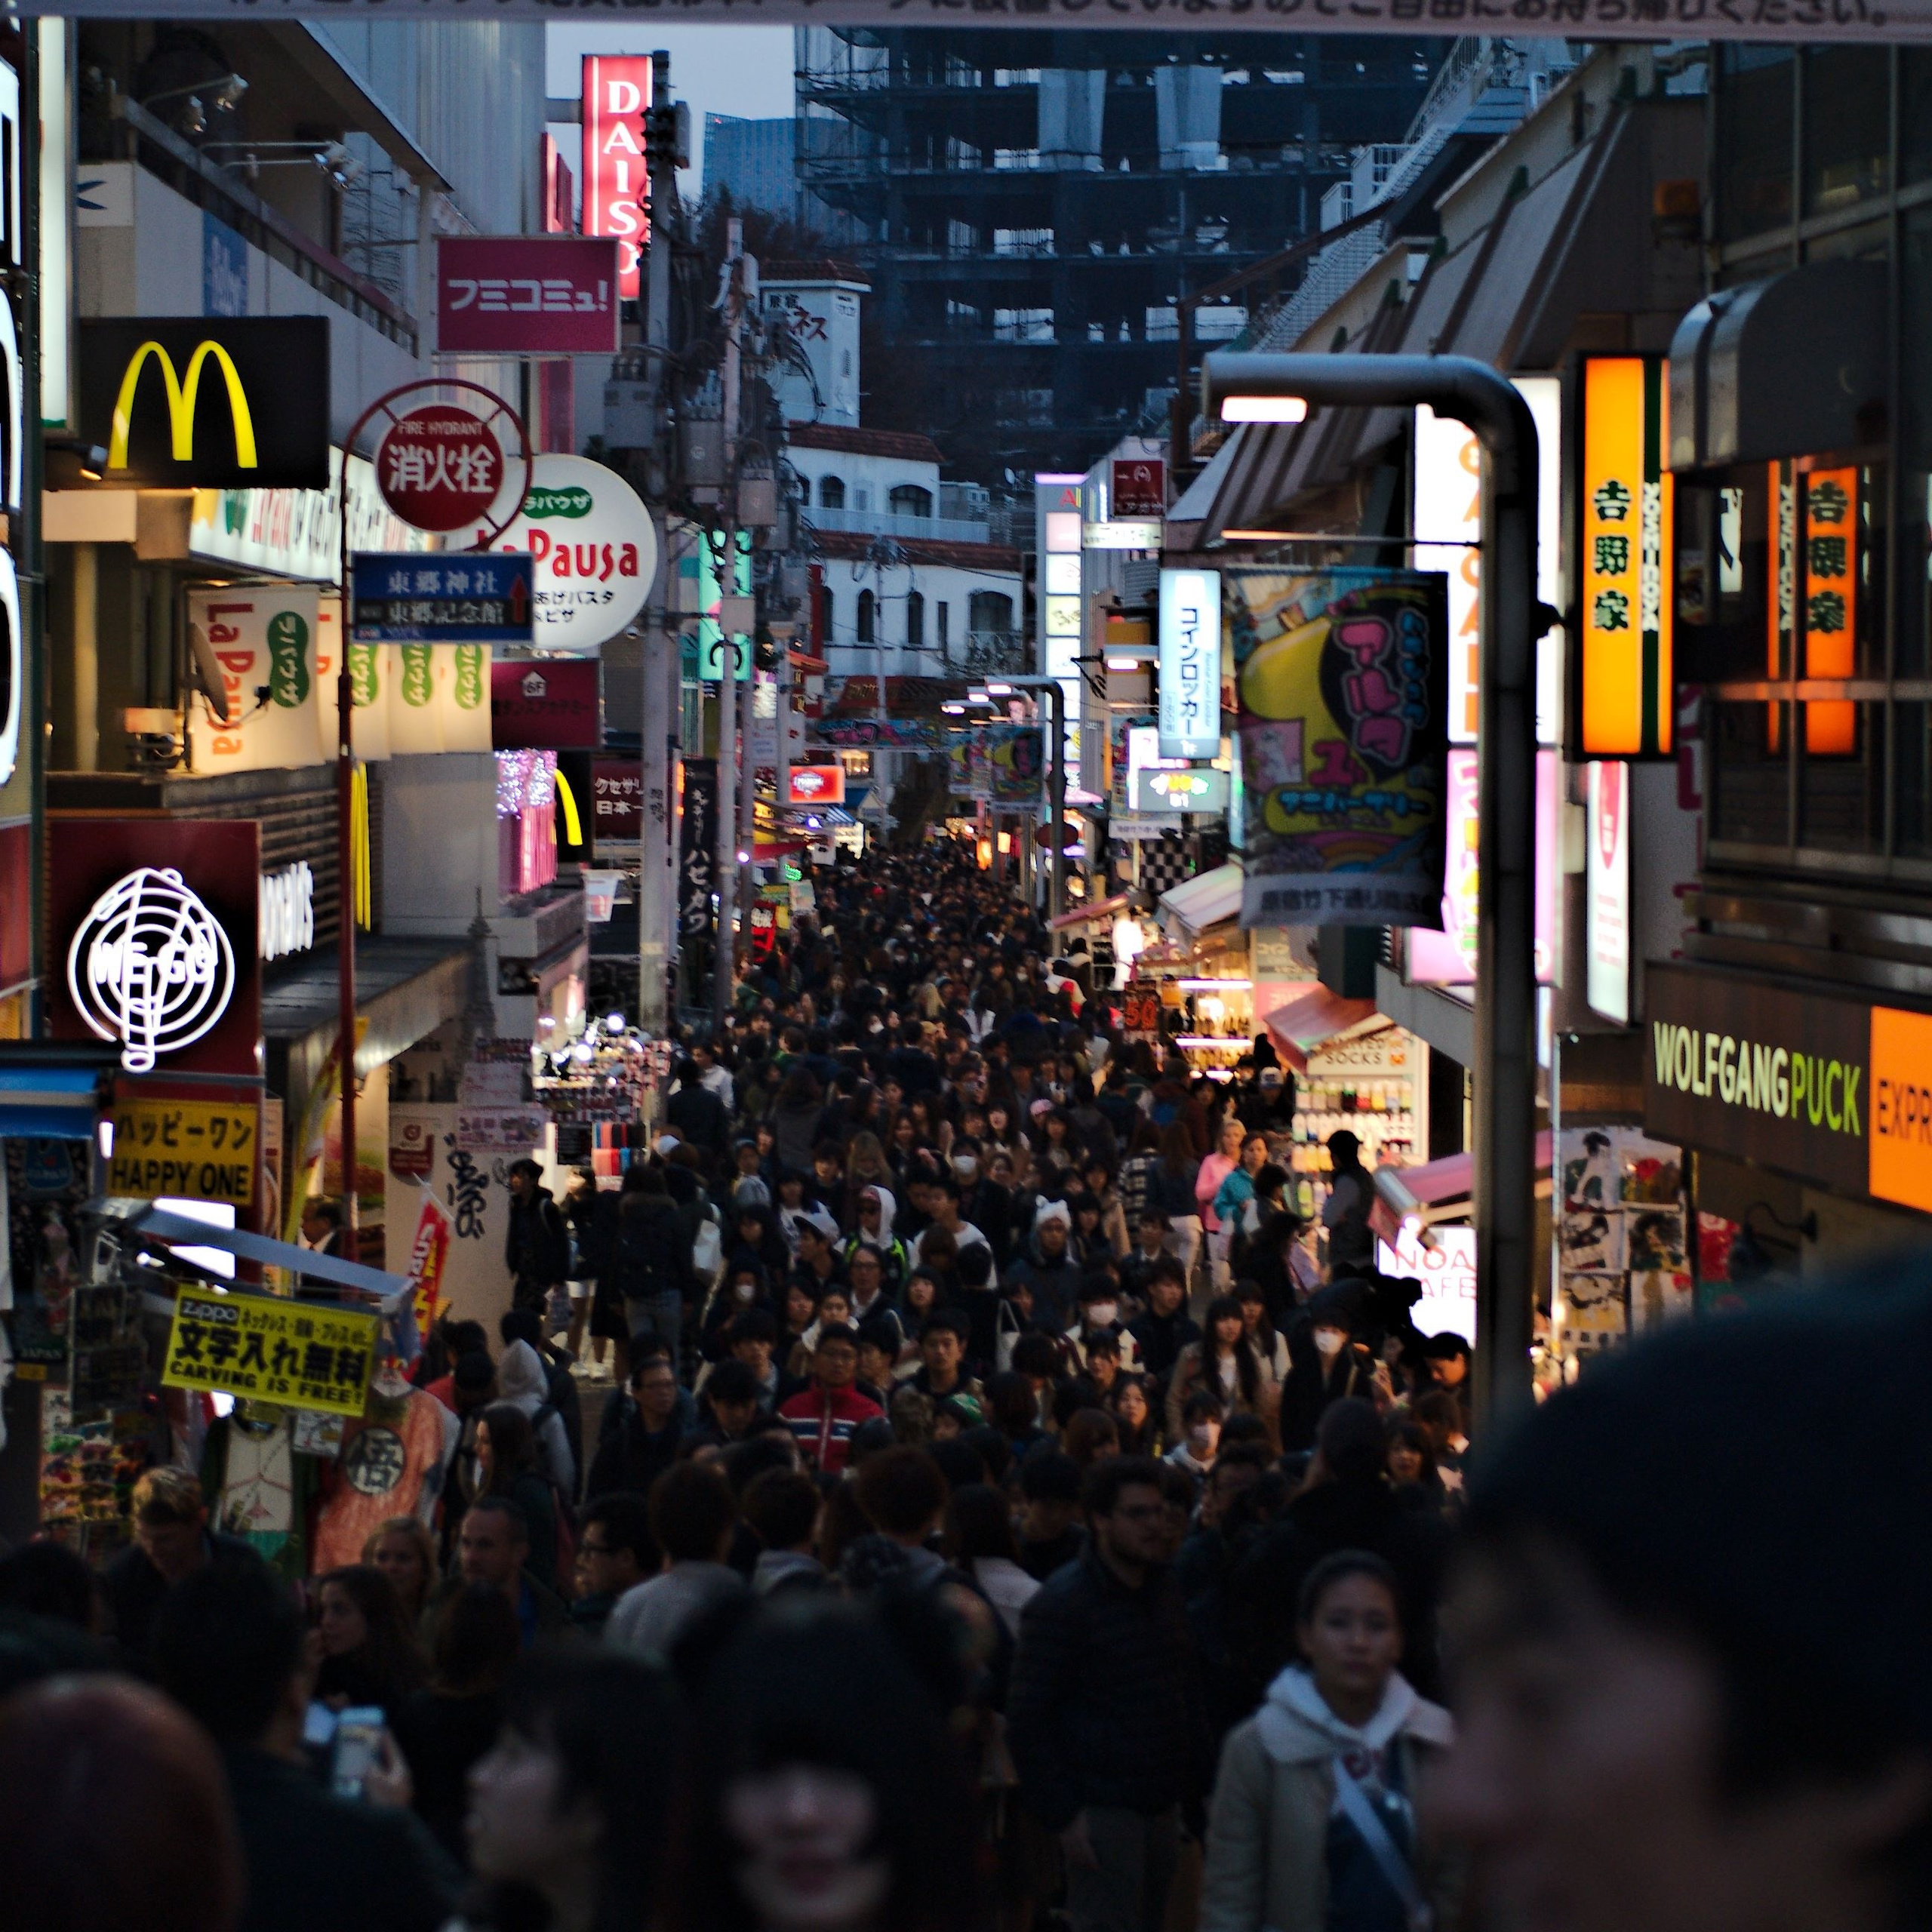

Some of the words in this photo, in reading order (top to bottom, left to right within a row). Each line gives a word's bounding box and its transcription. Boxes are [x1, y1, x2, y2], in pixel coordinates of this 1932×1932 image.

[398, 420, 426, 436] FIRE
[428, 420, 483, 436] HYDRANT
[389, 444, 496, 493] 消火栓
[528, 528, 640, 583] Pausa
[1180, 607, 1199, 735] コインロッカー
[1325, 1052, 1382, 1066] SOCKS
[116, 1109, 252, 1149] ハッピーワン
[112, 1158, 191, 1195] HAPPY
[199, 1162, 251, 1198] ONE
[1394, 1244, 1476, 1272] NOA
[1419, 1277, 1476, 1300] AFE
[174, 1321, 367, 1388] 文字入れ無料
[169, 1360, 257, 1389] CARVING
[266, 1376, 291, 1395] IS
